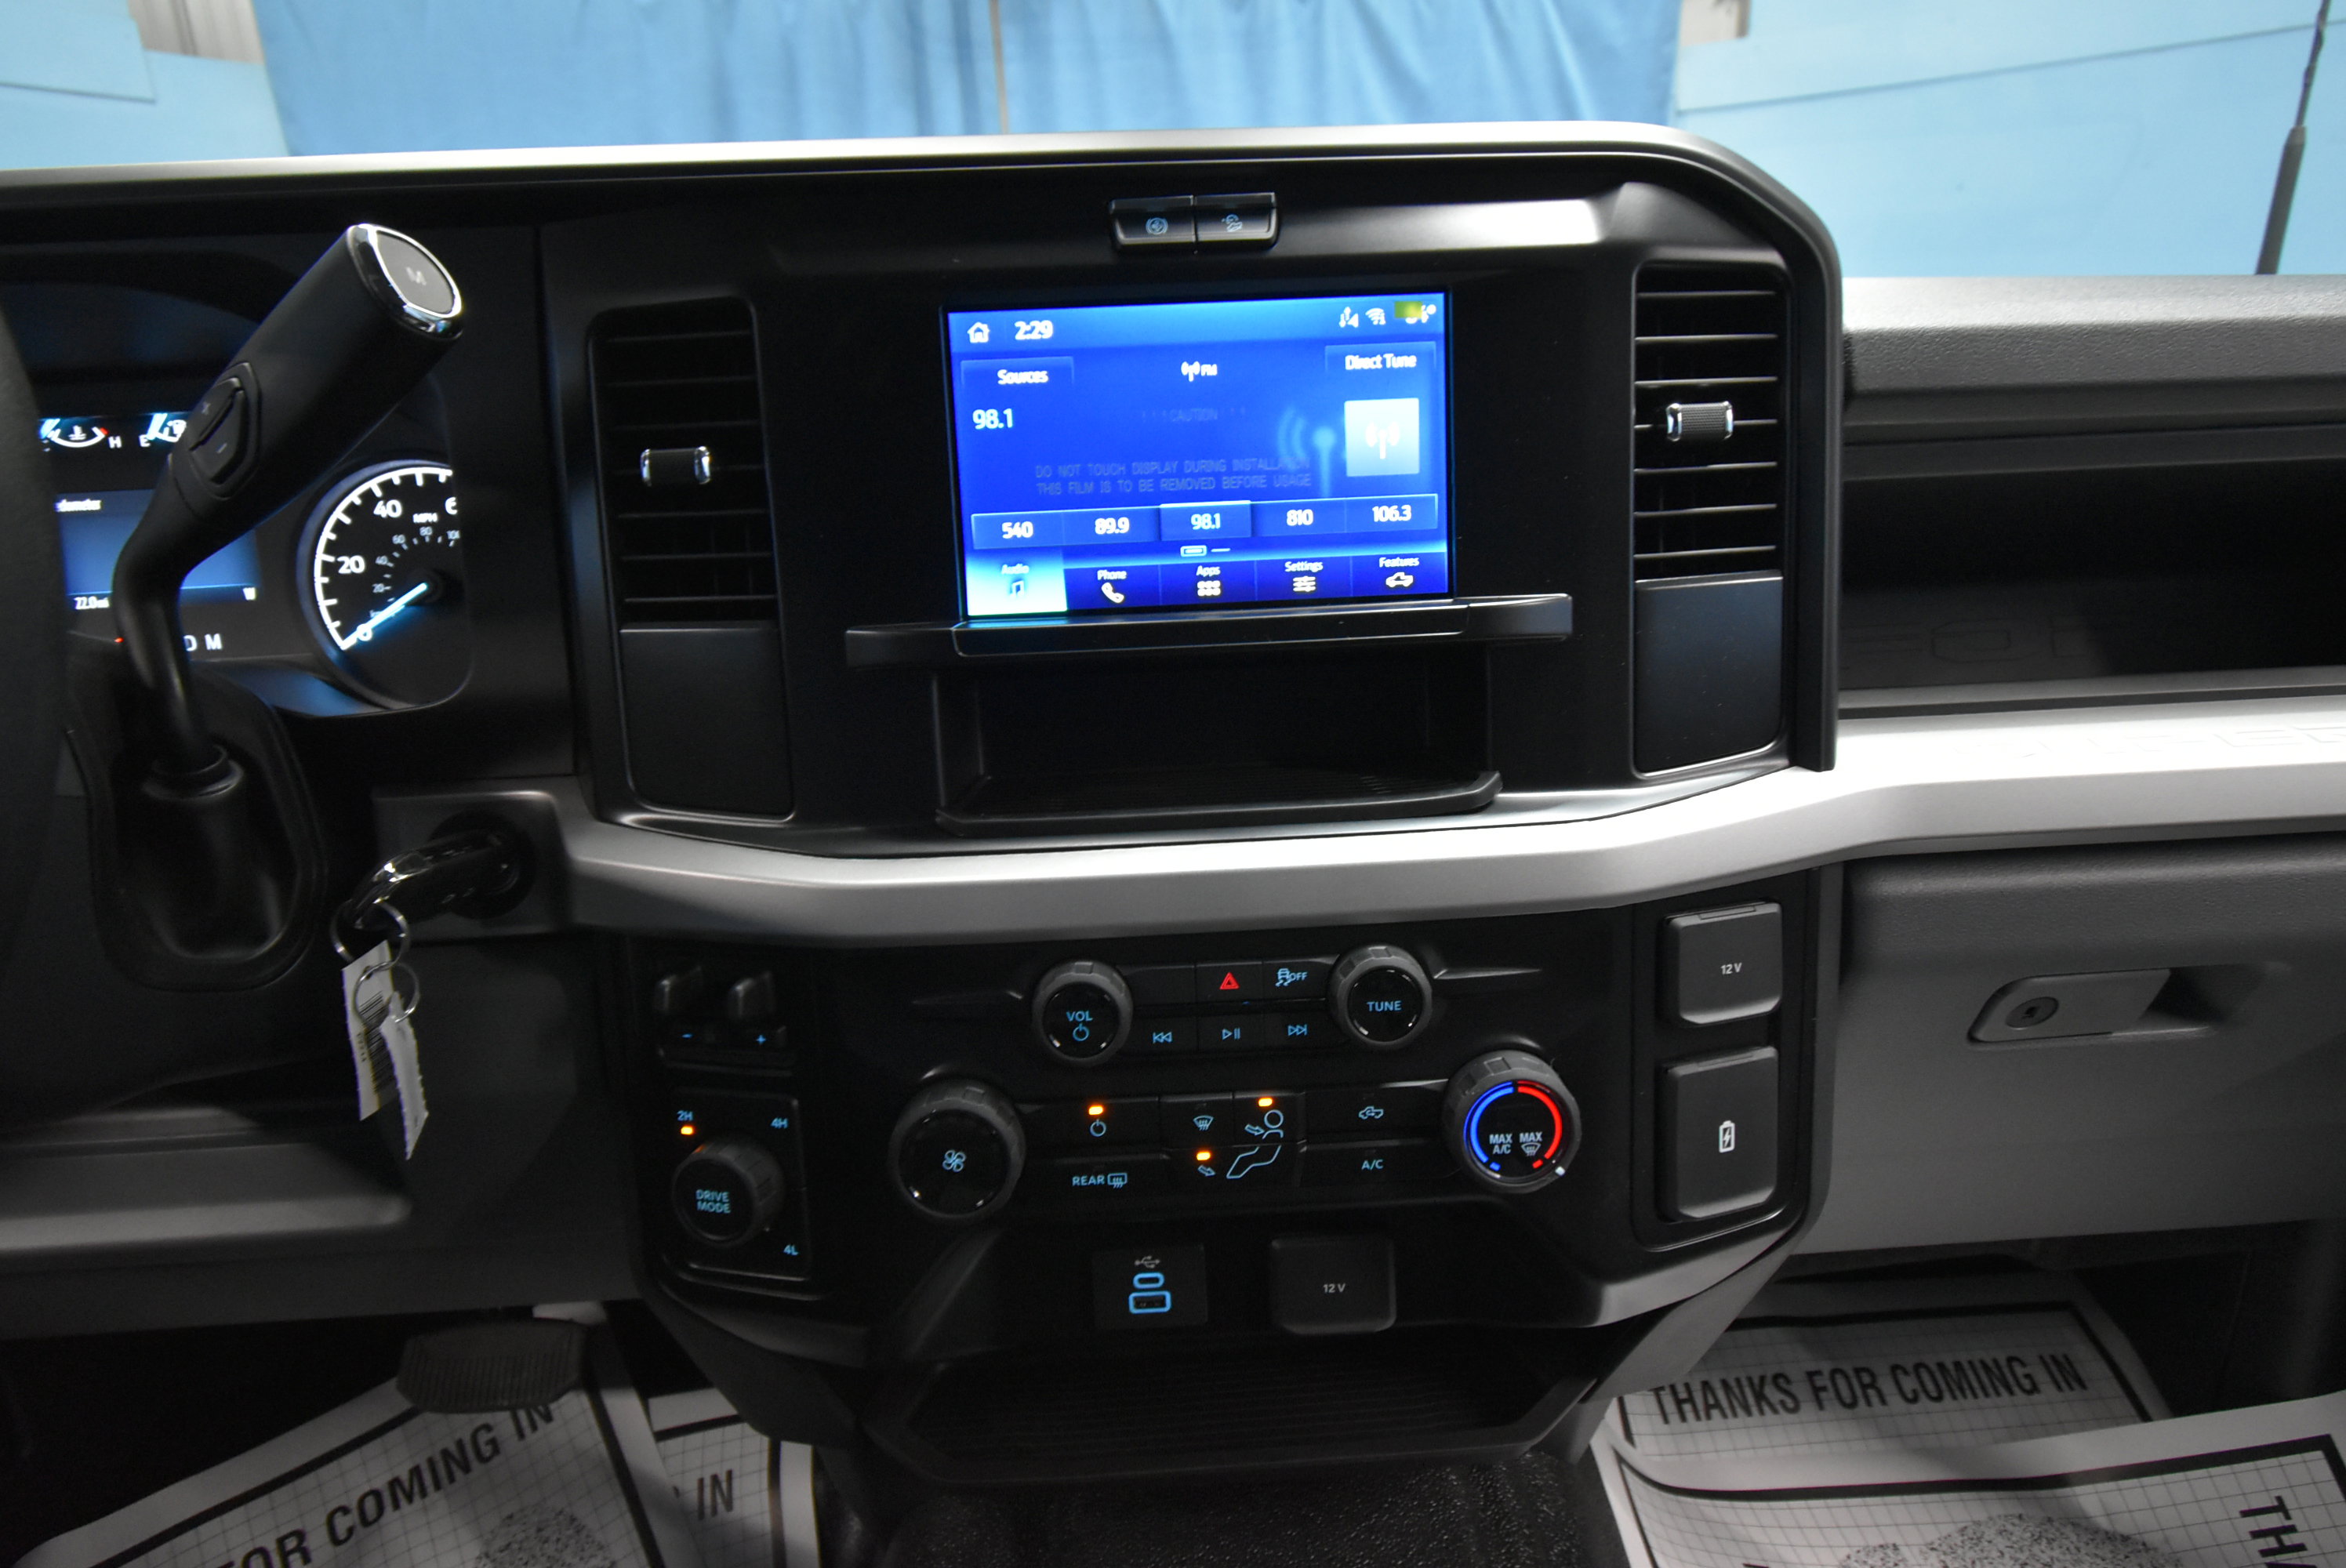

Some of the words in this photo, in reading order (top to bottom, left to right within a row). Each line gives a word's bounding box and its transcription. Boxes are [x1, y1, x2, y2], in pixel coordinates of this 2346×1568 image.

[1014, 320, 1054, 339] 2:29
[1345, 354, 1383, 370] Direct
[1383, 353, 1417, 368] Tune
[997, 368, 1049, 385] Sources
[971, 408, 1014, 430] 98.1
[108, 436, 122, 448] H
[1059, 463, 1081, 477] NOT
[1088, 463, 1126, 477] TOUCH
[1131, 461, 1178, 475] DISPLAY
[1184, 459, 1227, 474] DURING
[1068, 481, 1095, 495] FILM
[1117, 479, 1133, 492] TO
[1138, 478, 1155, 492] BE
[1160, 477, 1216, 491] REMOVED
[1222, 475, 1268, 489] BEFORE
[372, 499, 403, 518] 40
[1372, 504, 1412, 522] 106.3
[1190, 513, 1221, 530] 98.1
[1286, 509, 1313, 526] 810
[1001, 521, 1033, 539] 540
[1095, 517, 1130, 535] 89.9
[336, 555, 365, 574] 20
[1284, 560, 1324, 573] Settings
[1378, 556, 1420, 568] Features
[1001, 563, 1030, 575] Audio
[1097, 569, 1127, 580] Phone
[1196, 564, 1221, 577] Apps
[1720, 964, 1733, 975] 12
[1734, 962, 1742, 973] V
[1290, 971, 1309, 981] OFF
[1366, 1000, 1403, 1012] TUNE
[1066, 1010, 1093, 1022] VOL
[677, 1110, 694, 1121] 2H
[770, 1117, 789, 1129] 4H
[1489, 1133, 1513, 1145] MAX
[1520, 1131, 1543, 1143] MAX
[1493, 1144, 1511, 1154] A/C
[1361, 1159, 1385, 1171] A/C
[1072, 1174, 1105, 1186] REAR
[695, 1189, 730, 1203] DRIVE
[696, 1200, 731, 1214] MODE
[783, 1244, 798, 1255] 4L
[1337, 1283, 1346, 1293] V
[1649, 1373, 1803, 1425] THANKS
[1805, 1366, 1889, 1411] FOR
[1890, 1355, 2043, 1405] COMING
[2037, 1352, 2090, 1394] IN
[325, 1422, 501, 1548] COMING
[696, 1468, 734, 1522] IN
